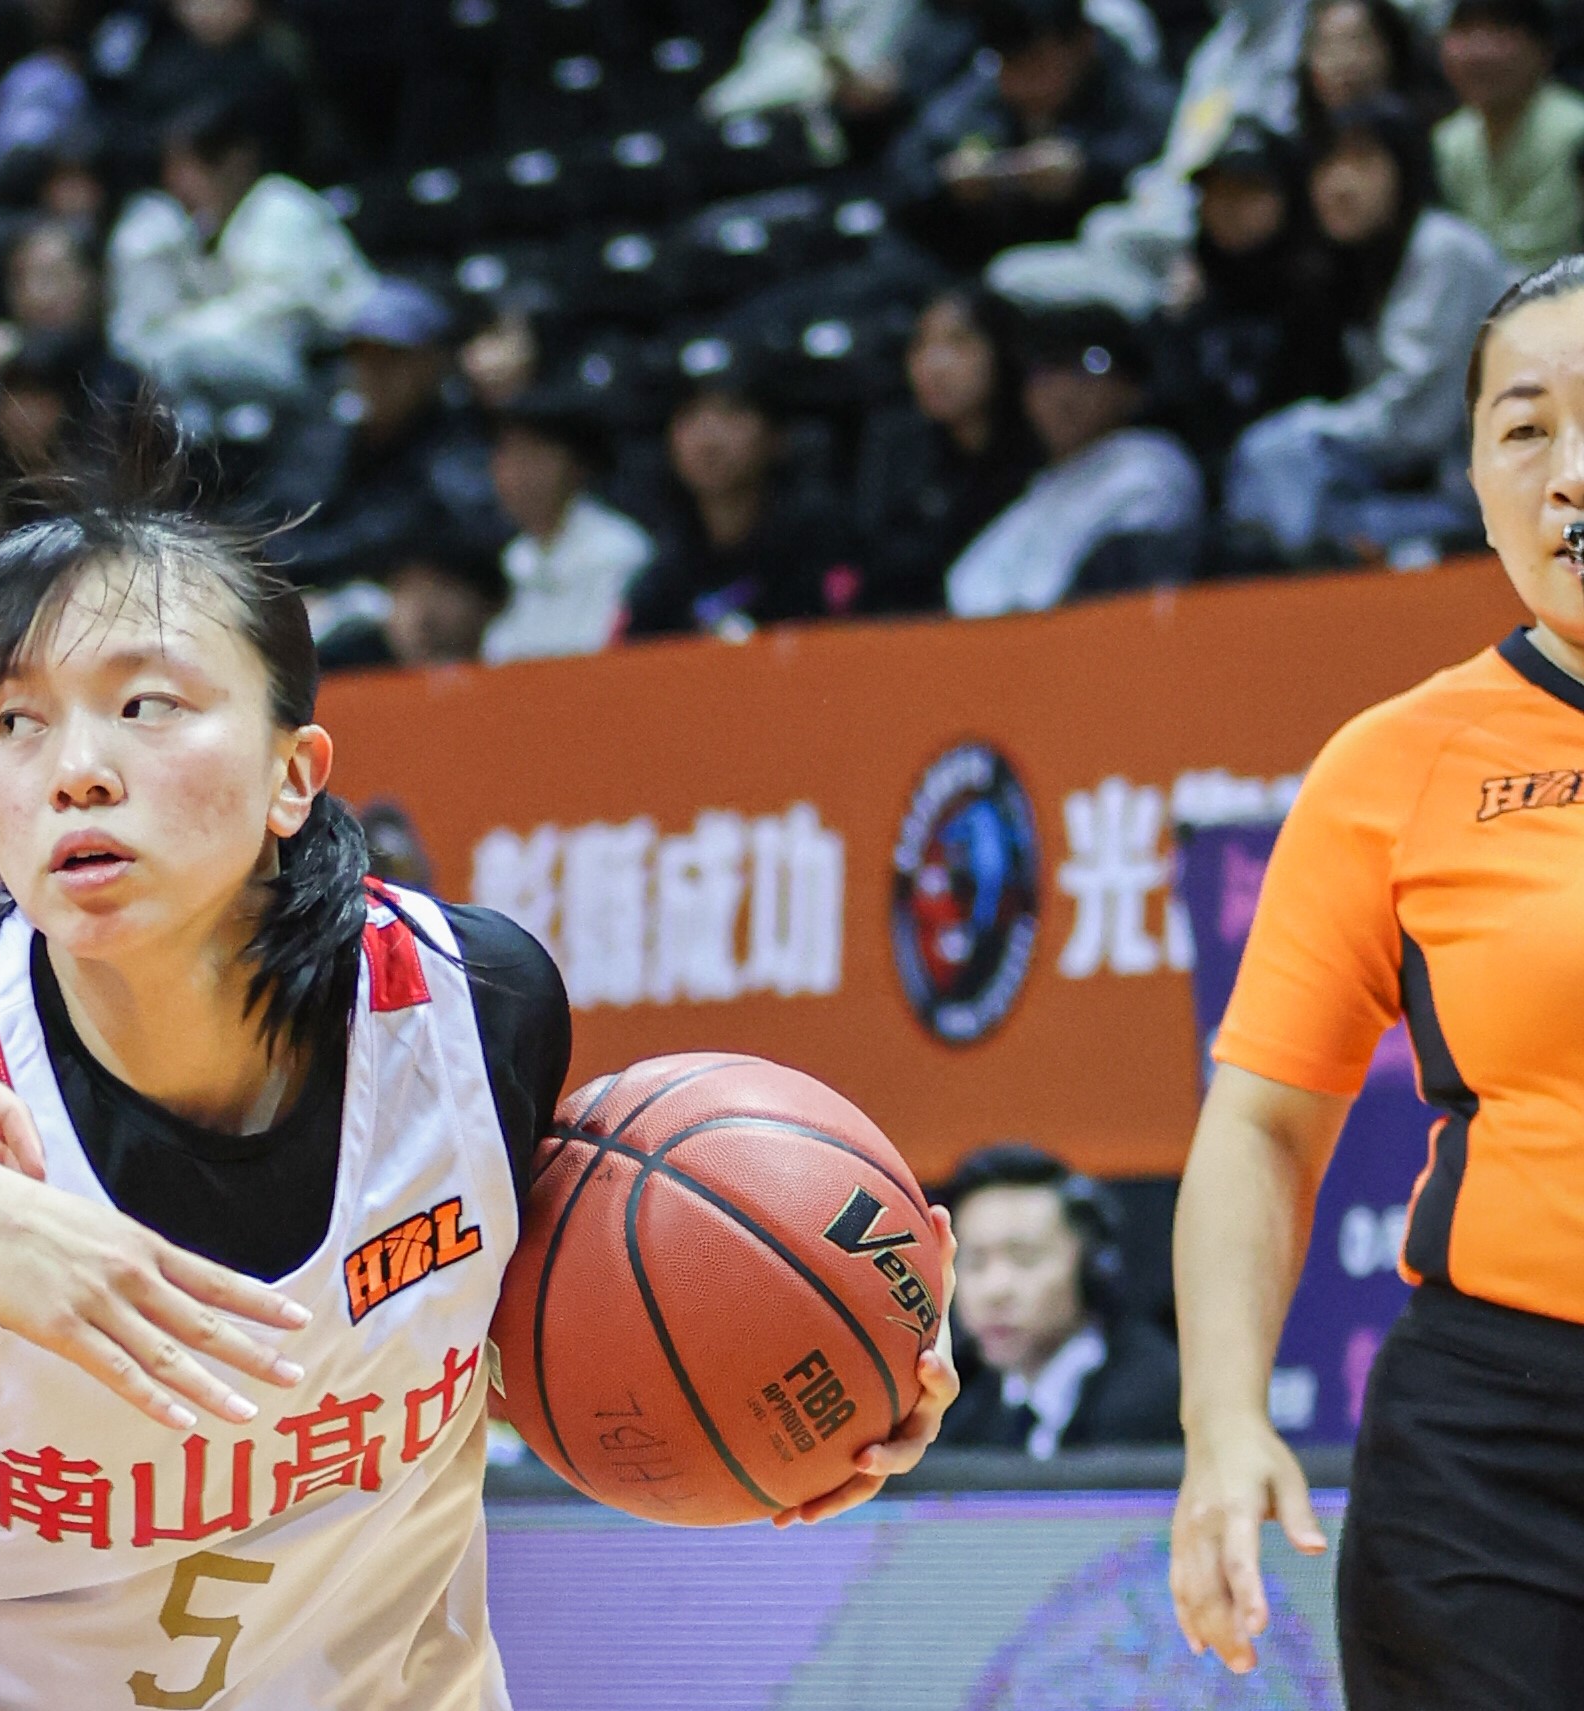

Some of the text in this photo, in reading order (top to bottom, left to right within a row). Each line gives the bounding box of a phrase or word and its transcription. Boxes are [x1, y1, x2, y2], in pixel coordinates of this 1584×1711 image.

[1476, 768, 1584, 822] HB
[344, 1195, 483, 1327] HBL
[761, 1382, 816, 1452] APPROVED
[782, 1348, 856, 1441] FIBA
[126, 1550, 276, 1711] 5
